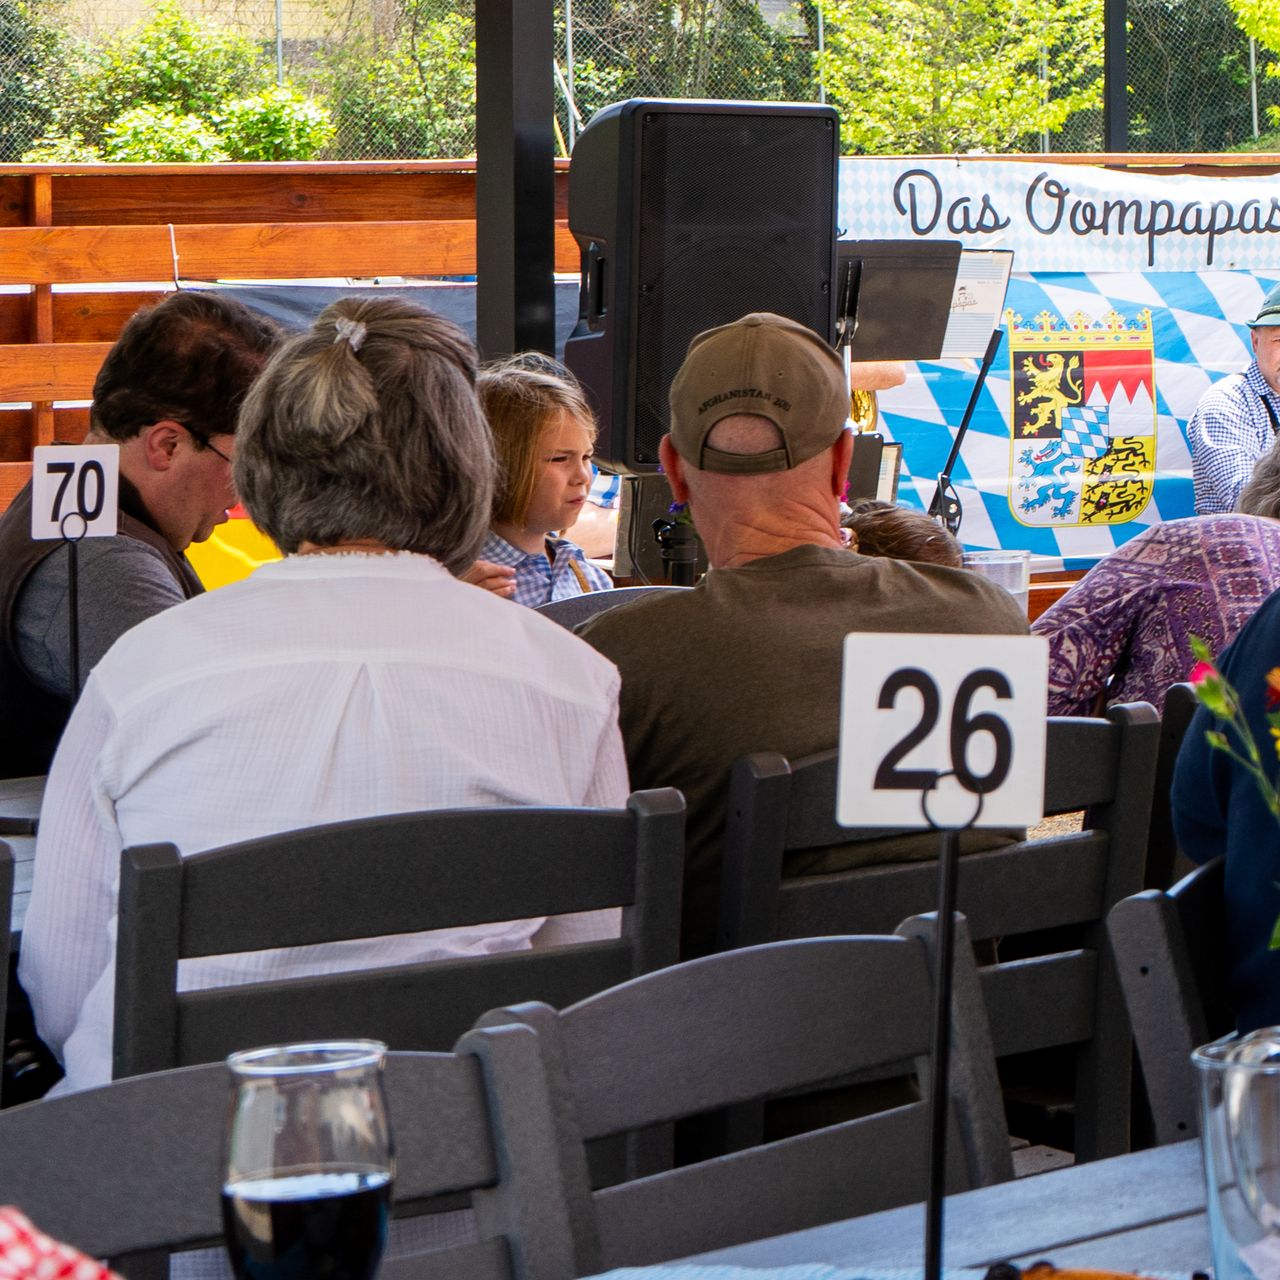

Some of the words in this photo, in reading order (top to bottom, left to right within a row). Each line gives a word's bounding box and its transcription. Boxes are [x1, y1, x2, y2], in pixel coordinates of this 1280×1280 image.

[893, 169, 1011, 236] Das
[46, 460, 105, 522] 70
[873, 666, 1014, 794] 26
